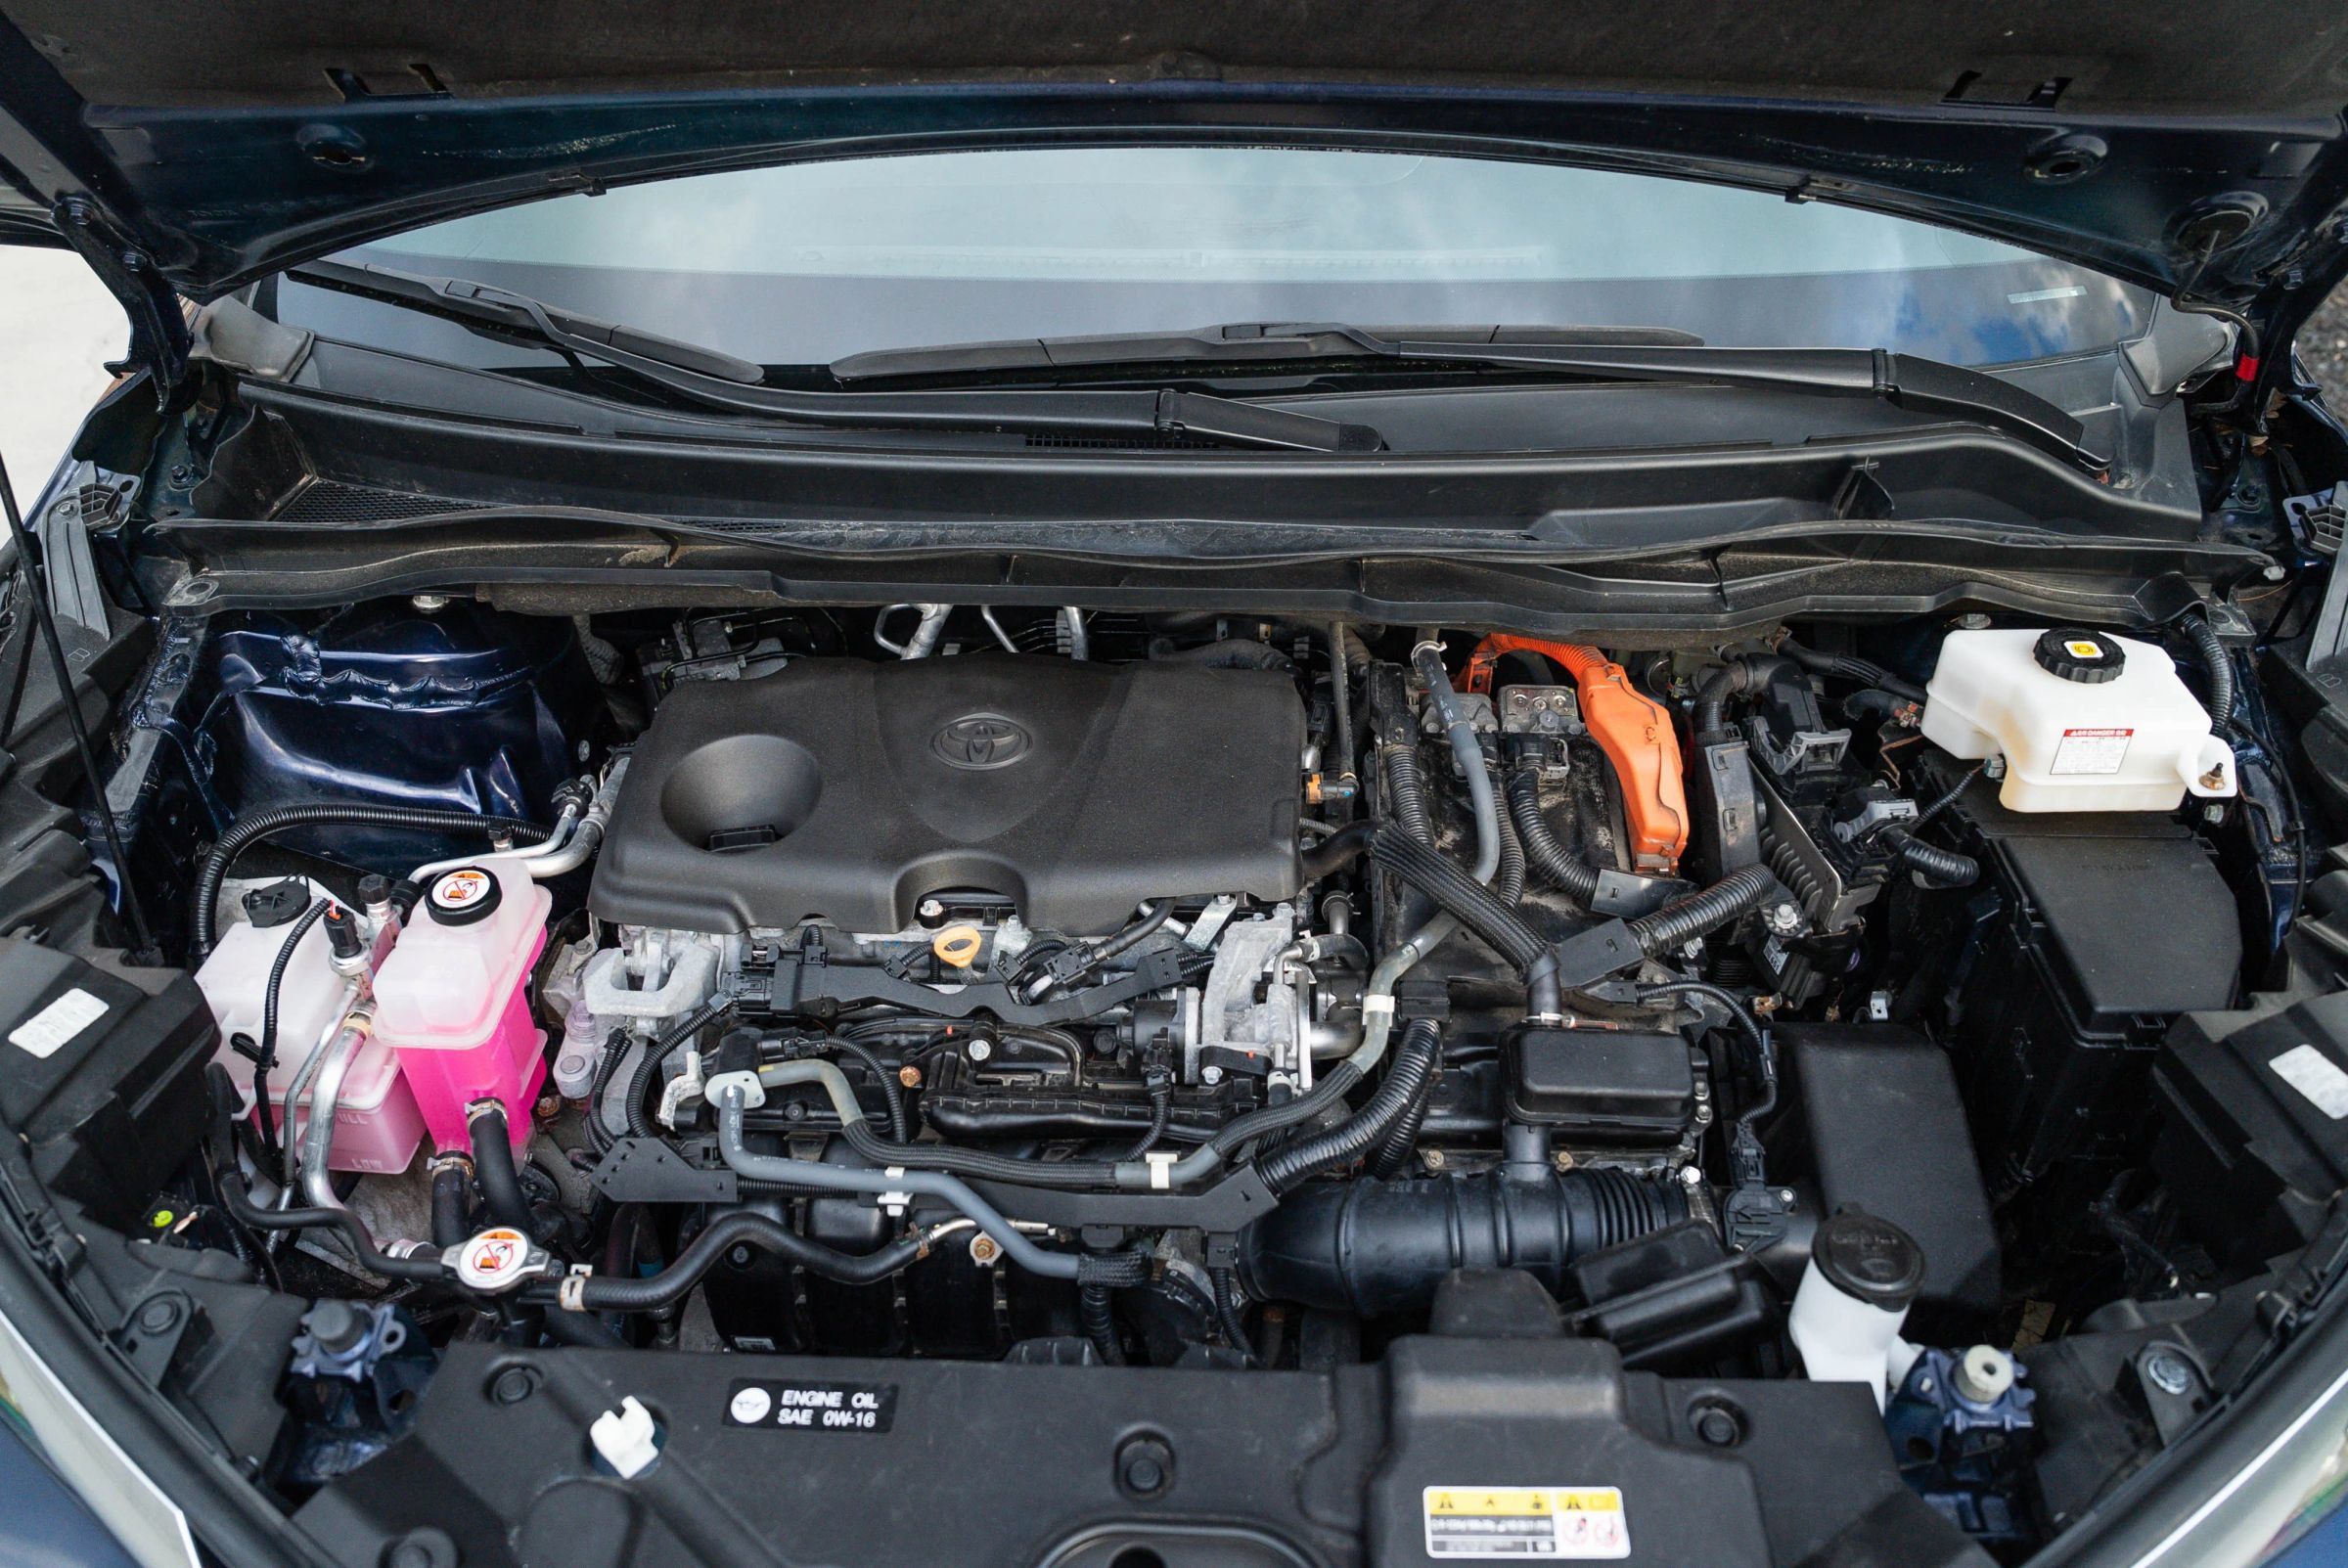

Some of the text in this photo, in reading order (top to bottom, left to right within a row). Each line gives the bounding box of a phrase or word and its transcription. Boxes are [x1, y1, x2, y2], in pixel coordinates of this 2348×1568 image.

[338, 1113, 368, 1125] ULL
[351, 1158, 384, 1170] LOW
[781, 1389, 879, 1410] ENGINE OIL
[777, 1409, 877, 1428] SAE 0W-16
